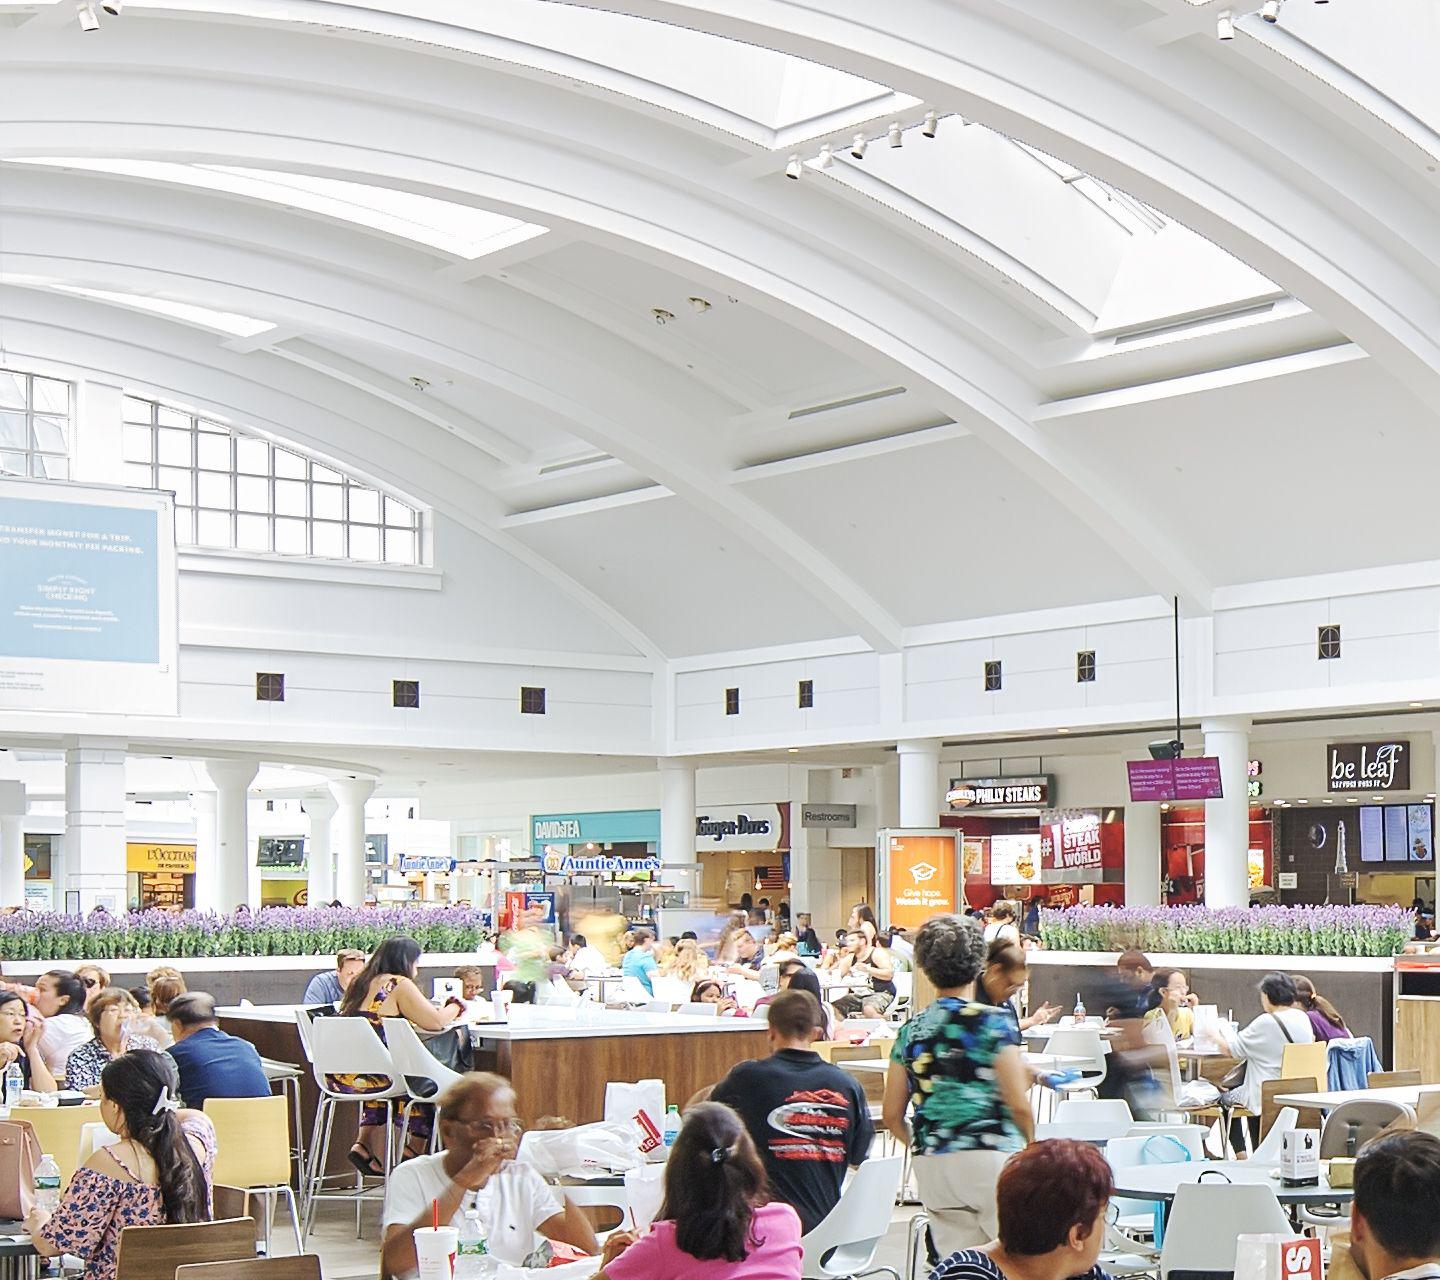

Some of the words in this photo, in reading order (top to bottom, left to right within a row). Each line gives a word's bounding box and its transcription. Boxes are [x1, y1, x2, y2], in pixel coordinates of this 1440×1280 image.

[1331, 750, 1355, 780] be
[1361, 744, 1403, 788] leaf
[975, 787, 1005, 804] PHILLY
[1005, 785, 1042, 802] STEAKS
[804, 811, 850, 823] Restrooms
[1063, 830, 1100, 849] STEAK
[564, 857, 613, 870] Auntie
[613, 856, 661, 870] Anne's
[1064, 849, 1102, 867] WORLD
[895, 897, 921, 906] Watch
[903, 889, 921, 898] Give
